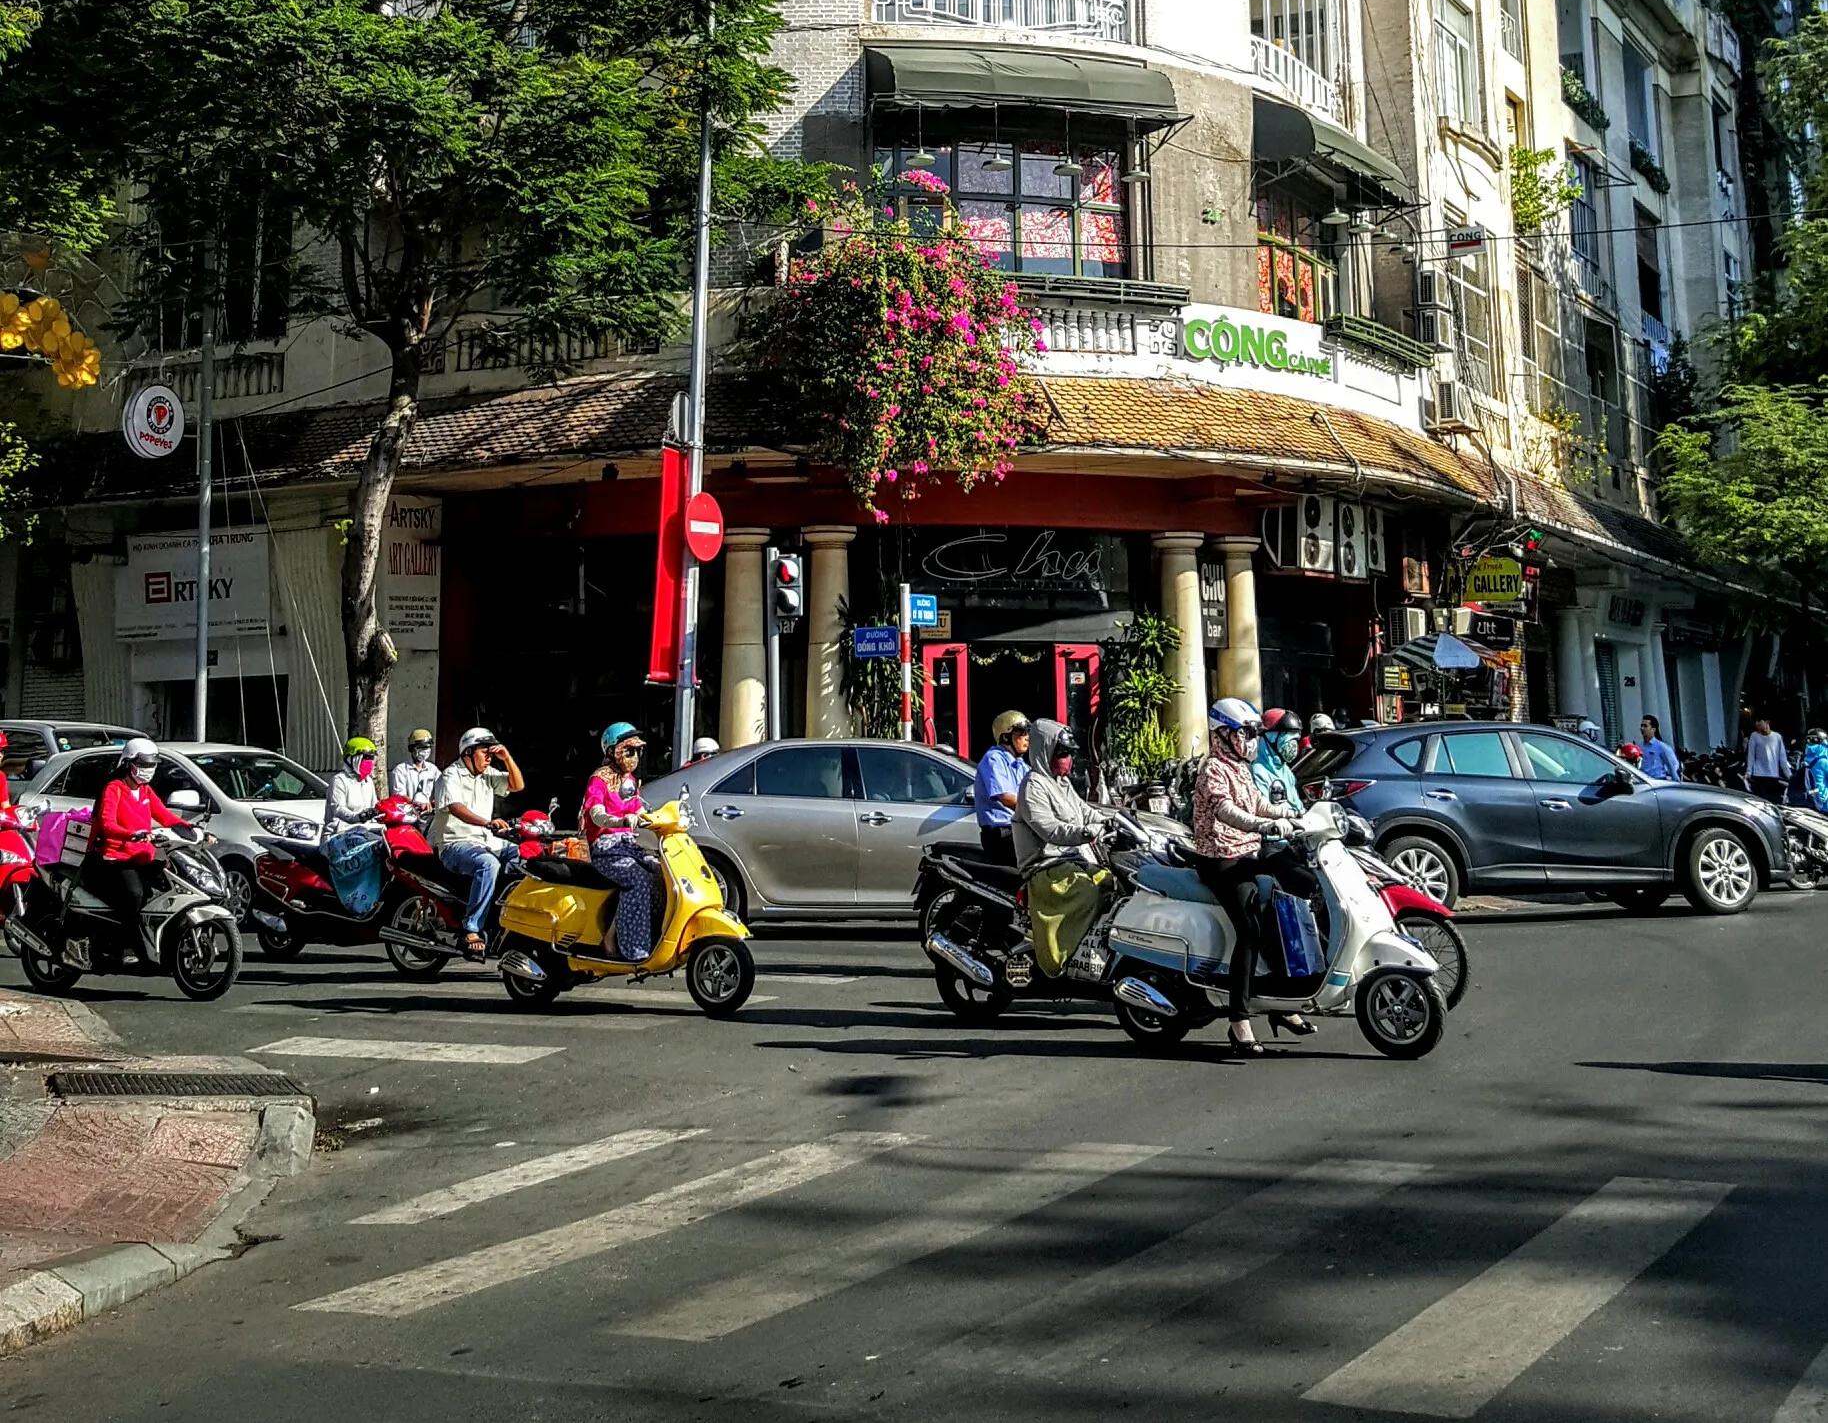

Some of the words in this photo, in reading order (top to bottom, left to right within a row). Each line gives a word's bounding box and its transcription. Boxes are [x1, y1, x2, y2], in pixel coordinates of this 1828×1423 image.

[1184, 314, 1287, 370] CỘNG
[389, 500, 436, 530] ARTSKY
[387, 542, 403, 575] ART
[404, 542, 438, 576] GALLERY
[1473, 574, 1520, 593] GALLERY
[1207, 619, 1222, 638] bar
[1088, 927, 1109, 937] EEP
[1082, 938, 1108, 950] ALM
